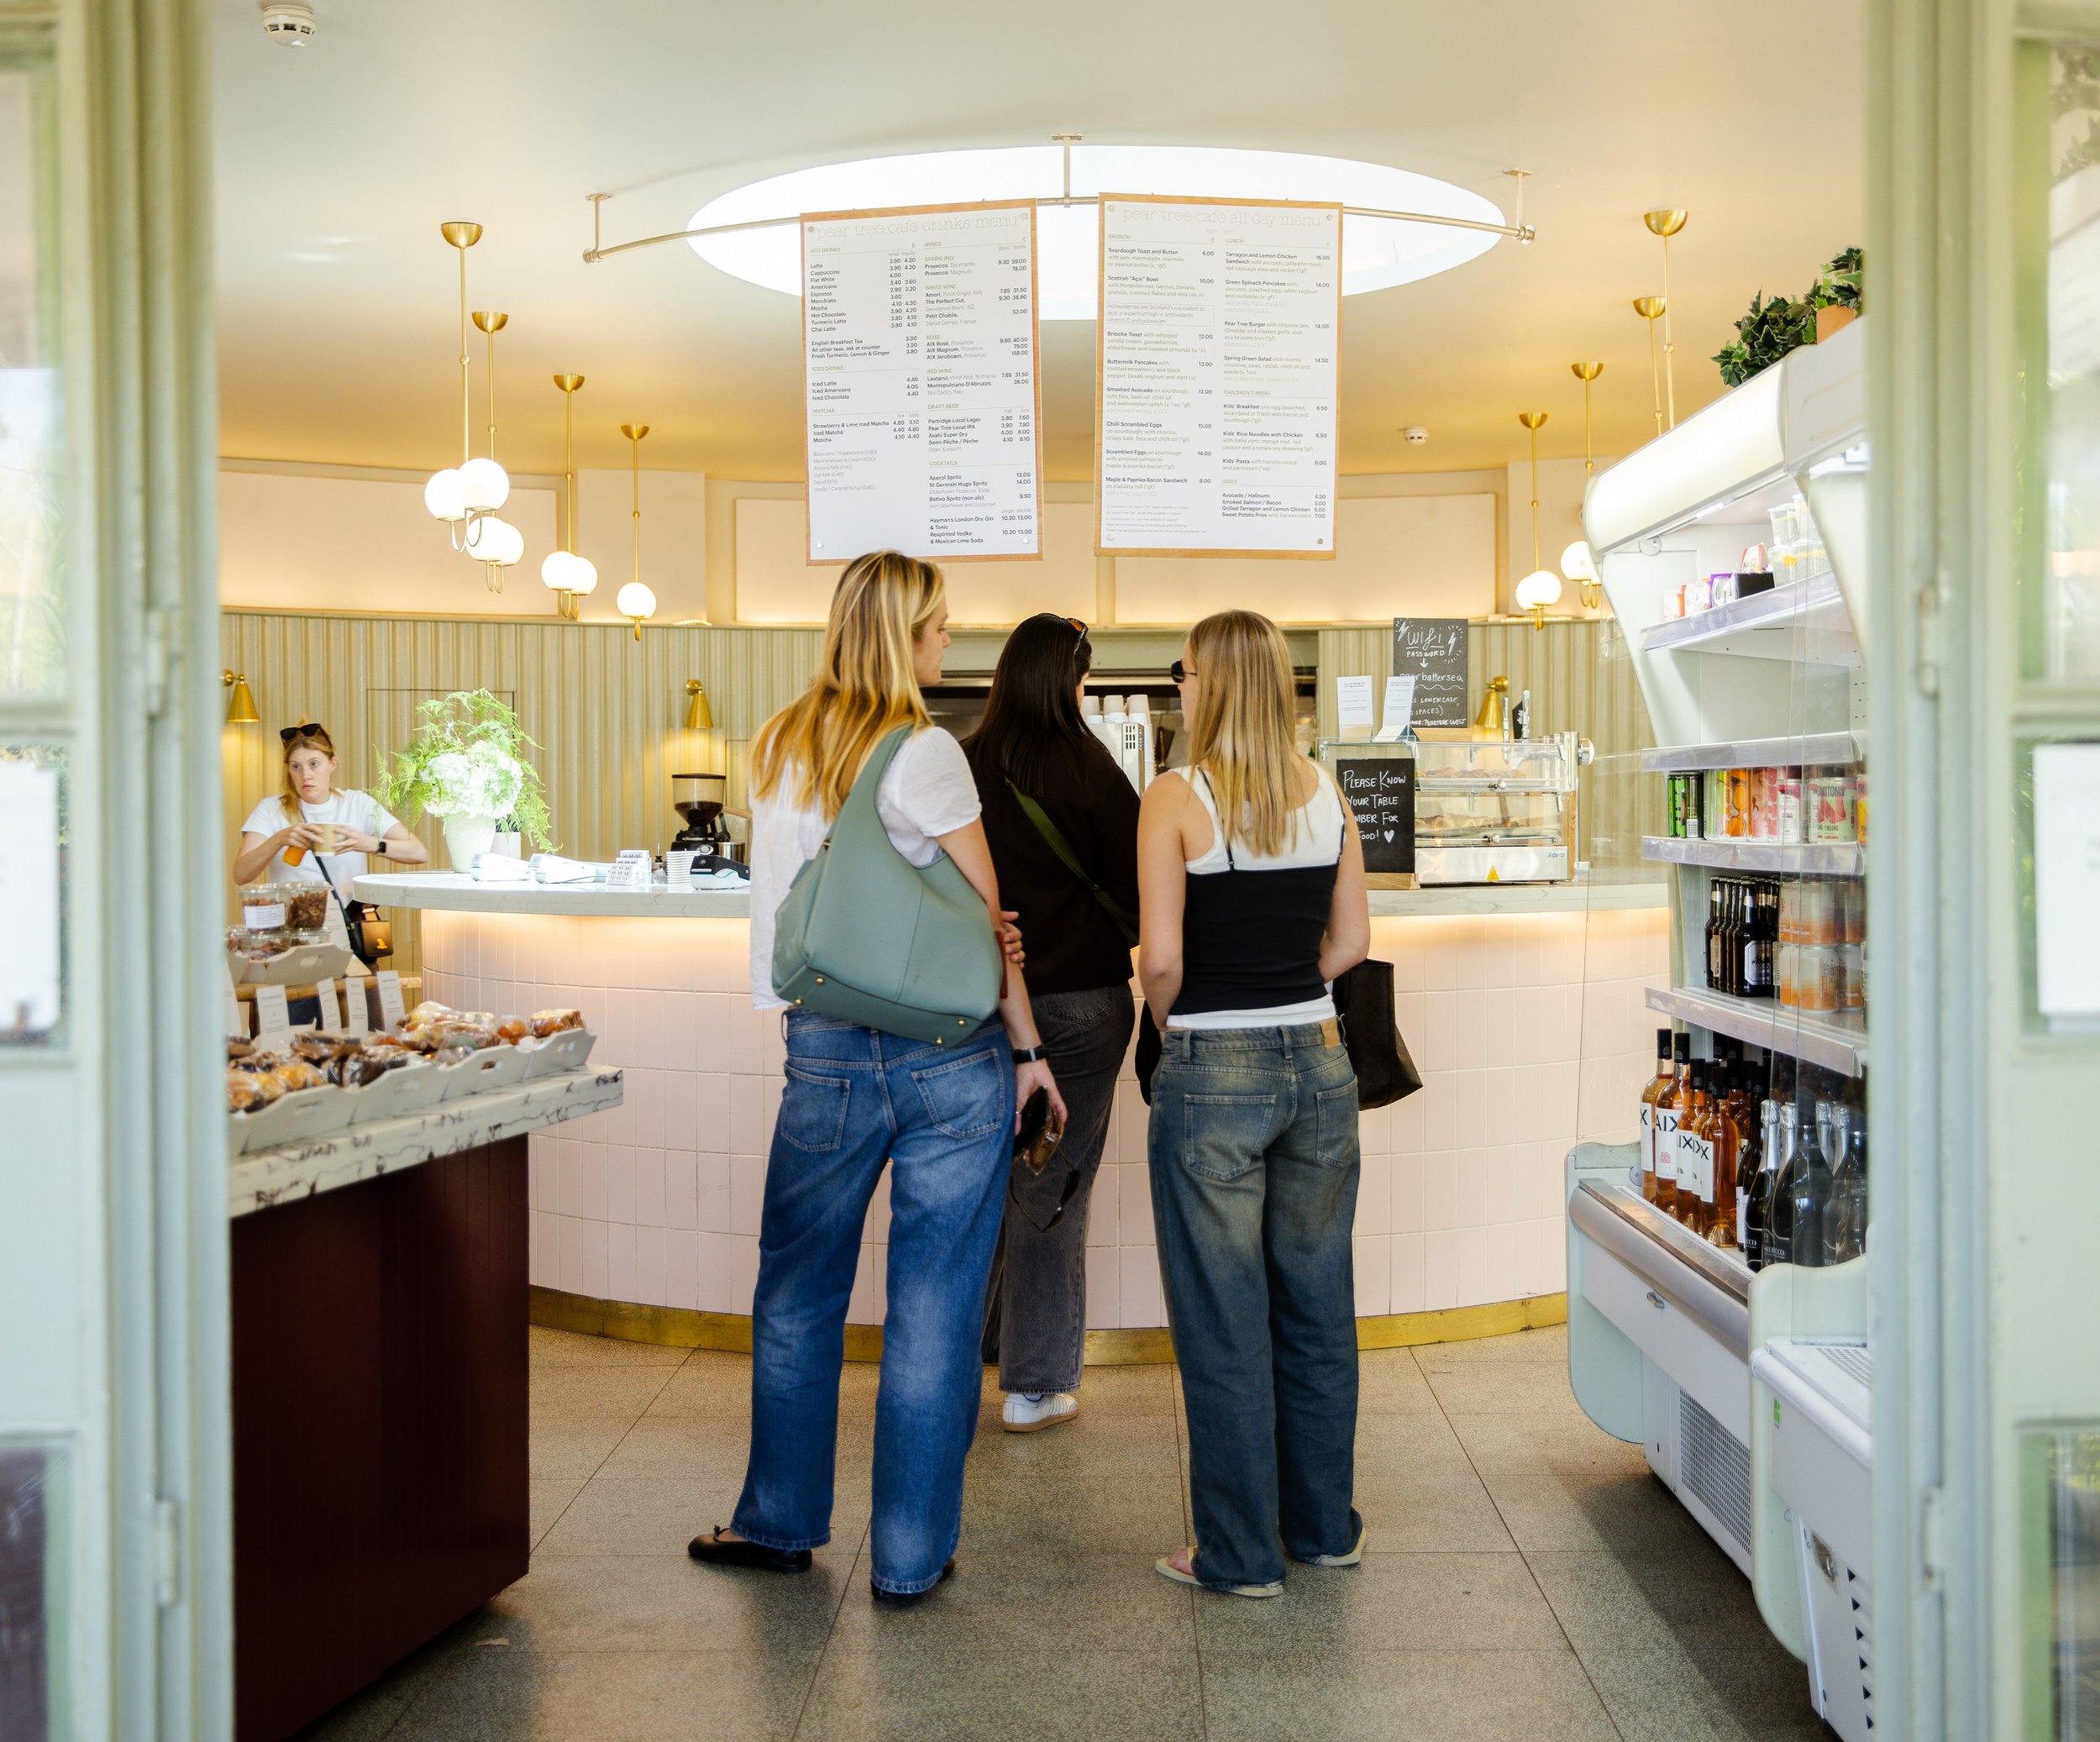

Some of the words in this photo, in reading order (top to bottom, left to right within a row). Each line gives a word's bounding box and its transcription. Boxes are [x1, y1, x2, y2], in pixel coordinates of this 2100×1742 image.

[1122, 209, 1158, 222] pear
[1163, 211, 1192, 222] tree
[1252, 213, 1275, 228] day
[1280, 215, 1320, 226] menu
[816, 226, 849, 242] pear
[855, 223, 884, 236] tree
[922, 218, 971, 232] drinks
[975, 215, 1018, 228] menu
[1354, 814, 1378, 823] MBER
